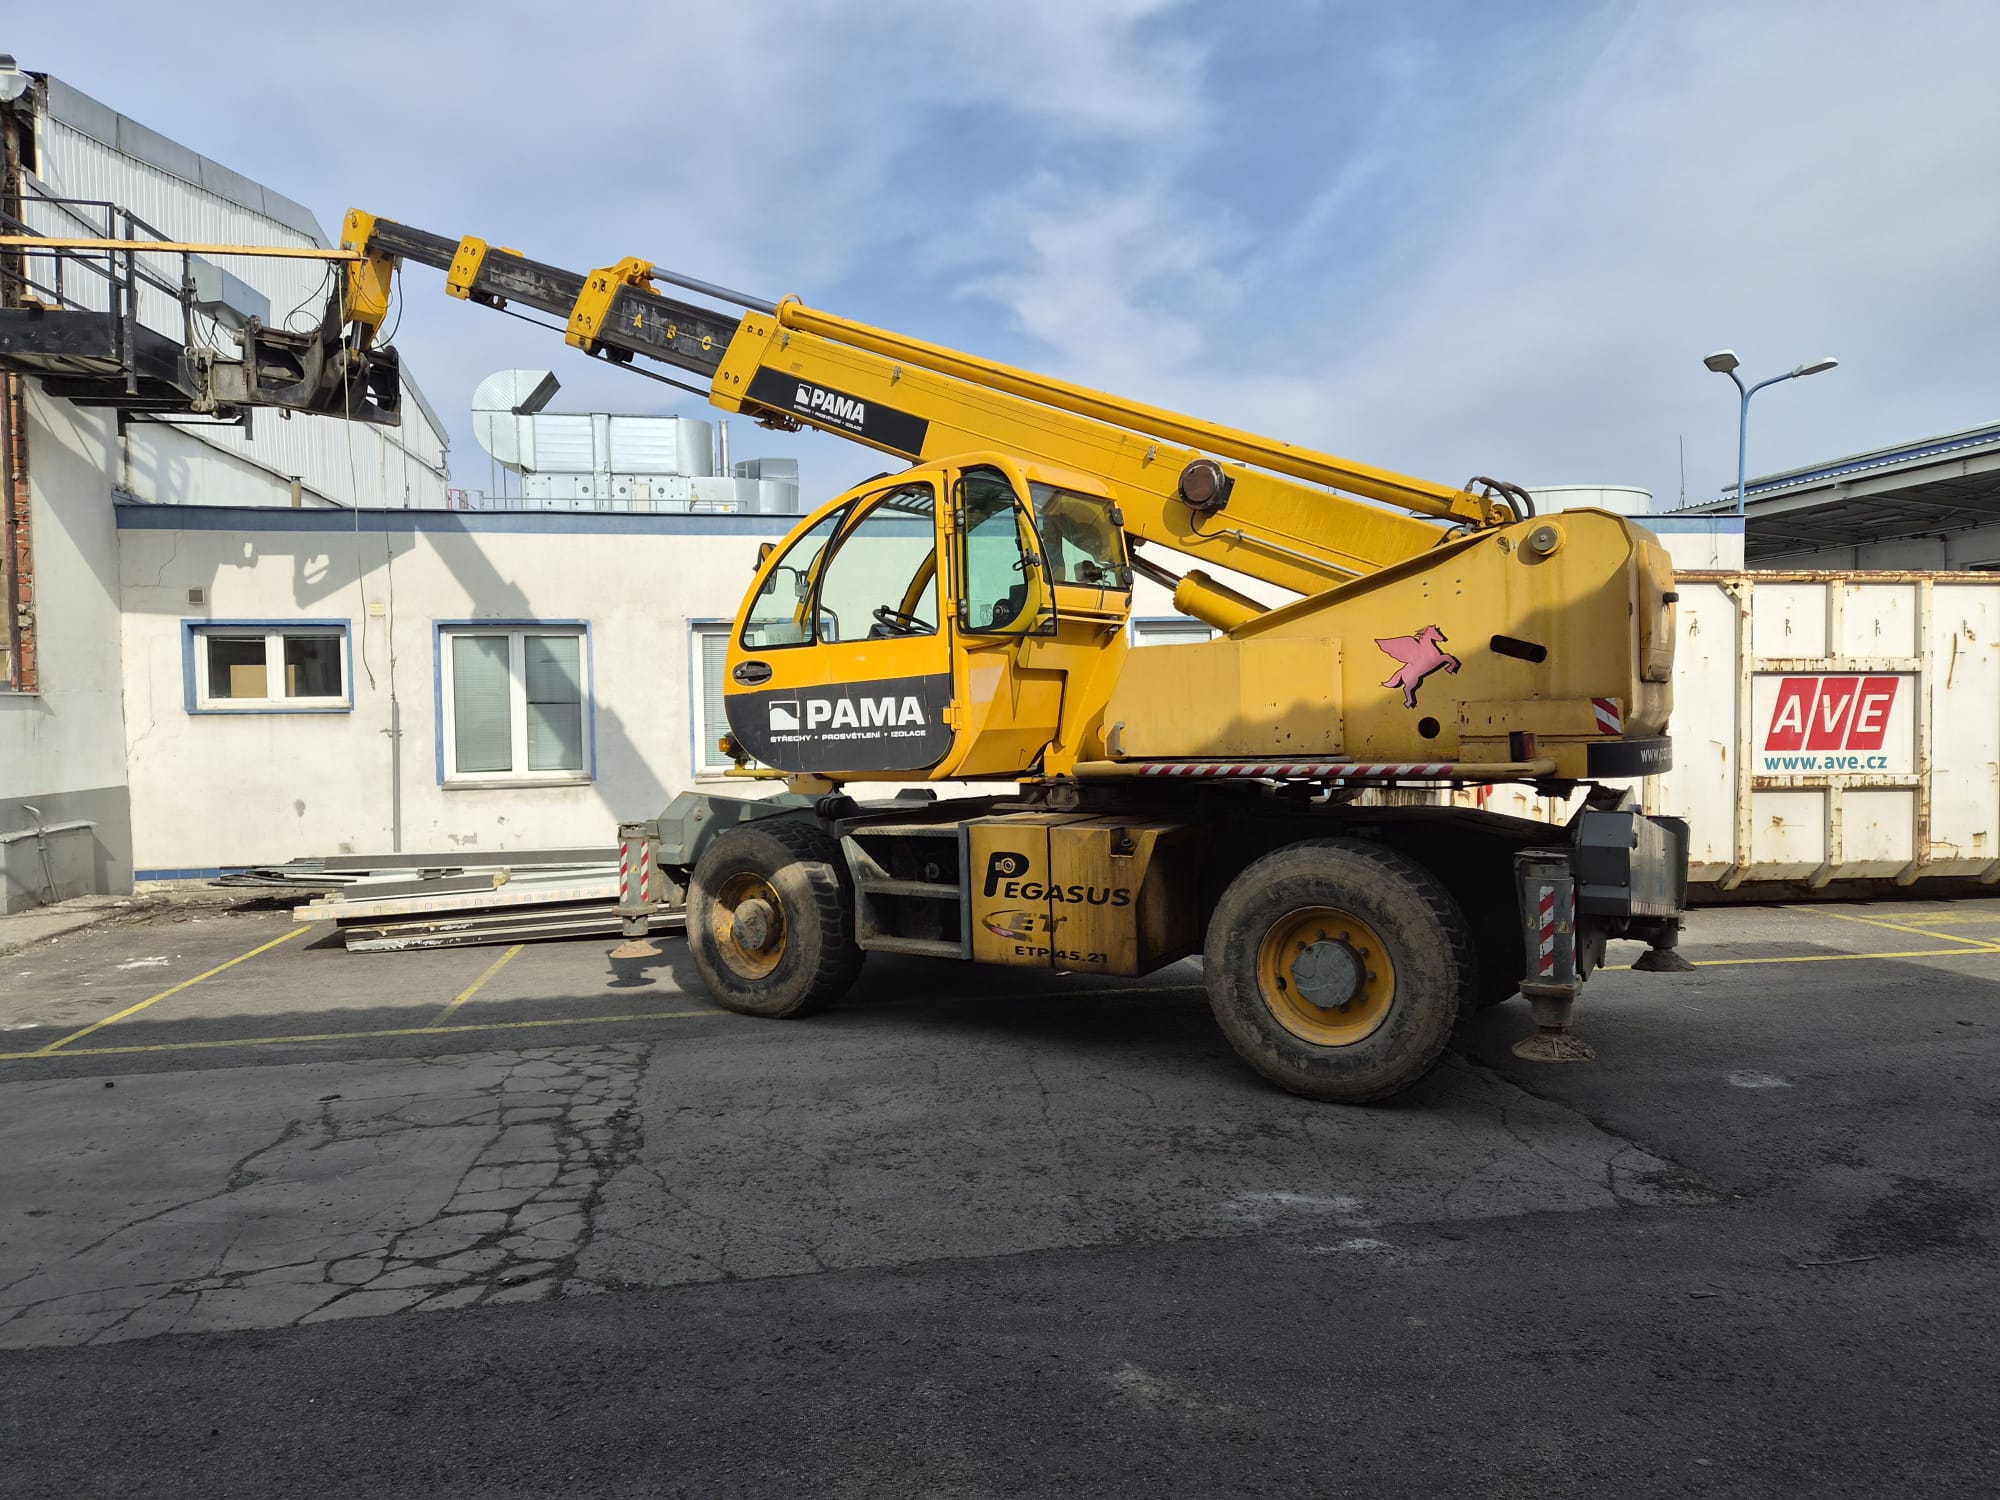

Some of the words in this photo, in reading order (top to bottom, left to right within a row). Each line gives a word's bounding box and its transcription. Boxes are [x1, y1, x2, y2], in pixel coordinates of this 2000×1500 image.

[633, 313, 643, 329] A
[810, 388, 865, 425] PAMA
[806, 696, 926, 730] PAMA
[1772, 694, 1890, 733] AVE
[770, 734, 811, 743] STŘECHY
[821, 730, 881, 741] PROSVĚTLENÍ
[890, 730, 927, 738] IZOLACE
[1764, 756, 1887, 770] www.ave.cz
[983, 851, 1131, 907] PEGASUS
[1015, 945, 1049, 958] ETP
[1056, 951, 1108, 964] 45.21
